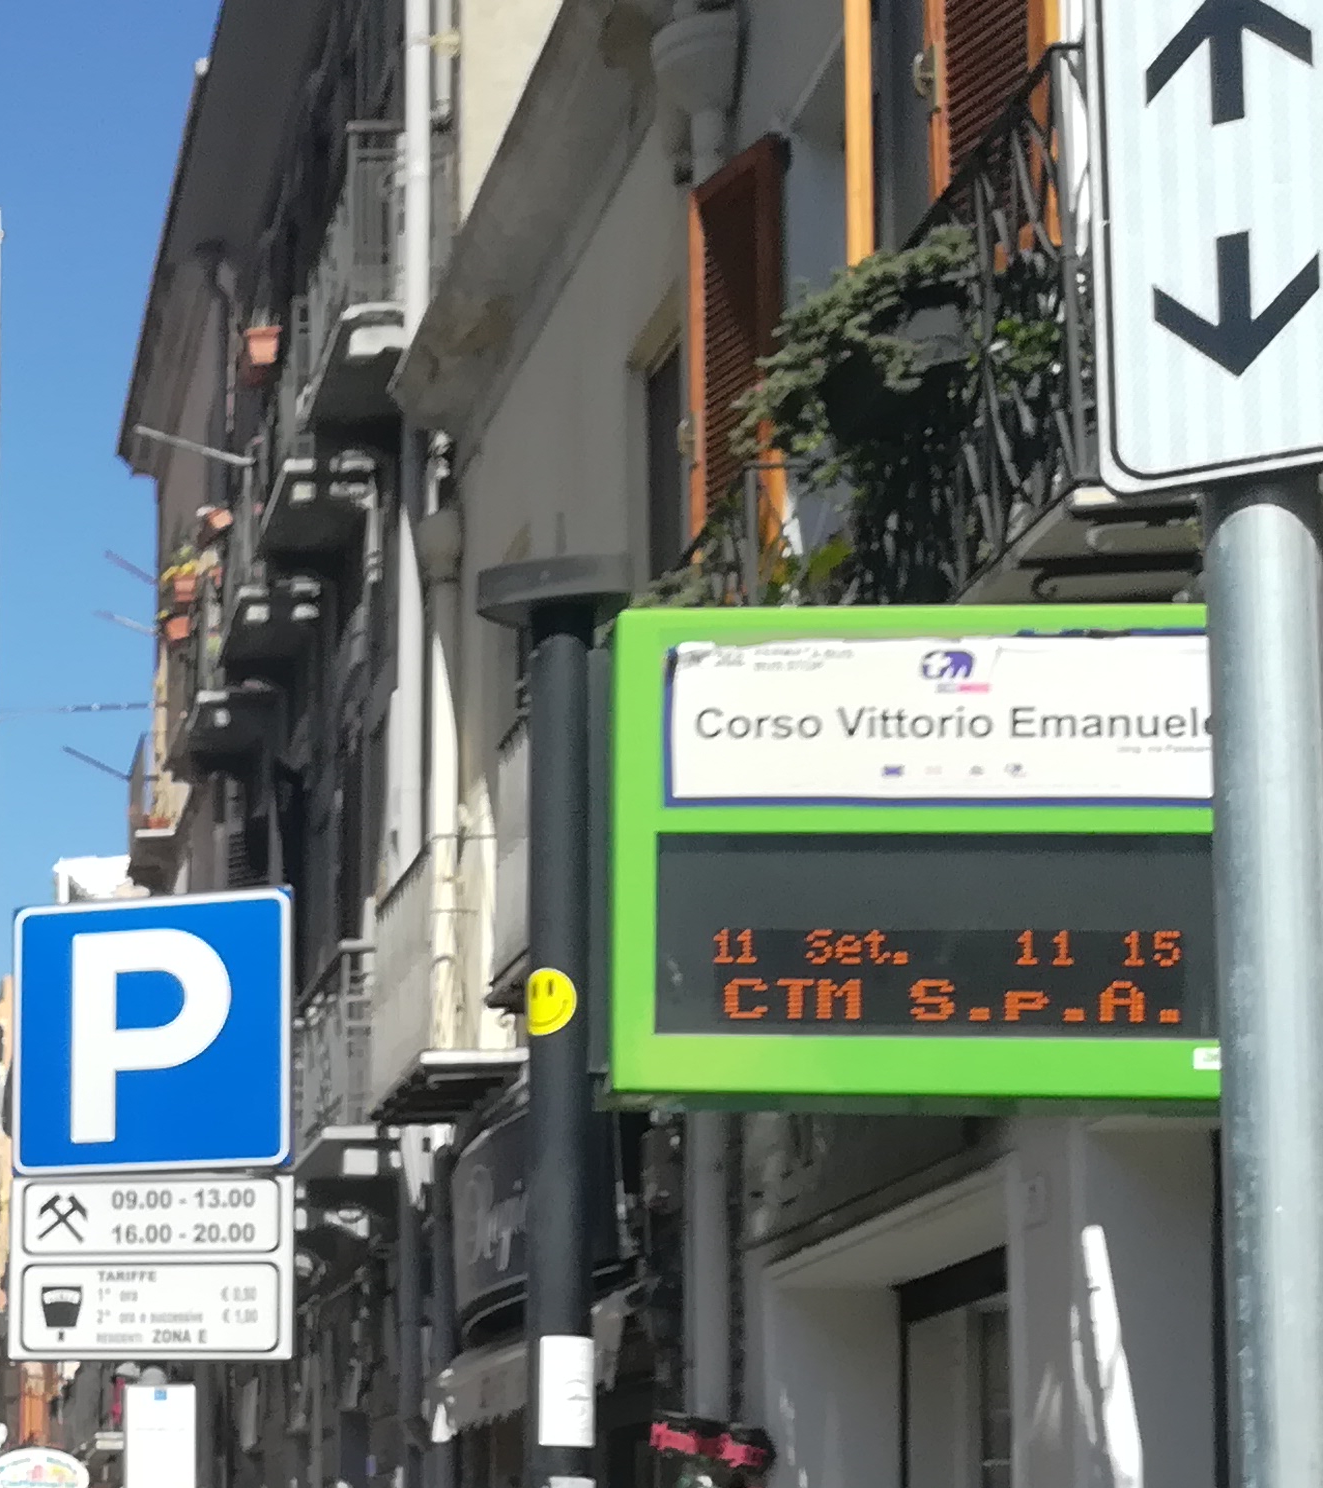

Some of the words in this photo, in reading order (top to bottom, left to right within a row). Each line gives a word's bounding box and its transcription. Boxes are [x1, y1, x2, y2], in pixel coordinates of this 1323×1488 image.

[696, 707, 823, 739] Corso
[837, 705, 994, 739] Vittorio
[713, 927, 757, 965] 11
[805, 928, 909, 966] Set.
[1015, 929, 1074, 966] 11
[1123, 930, 1183, 967] 15
[723, 978, 863, 1021] CTM
[70, 927, 232, 1145] P
[111, 1189, 173, 1210] 09.00
[194, 1187, 256, 1209] 13.00
[112, 1223, 173, 1244] 16.00
[193, 1222, 256, 1243] 20.00
[97, 1270, 157, 1283] TARIFFE
[151, 1328, 192, 1345] ZONA
